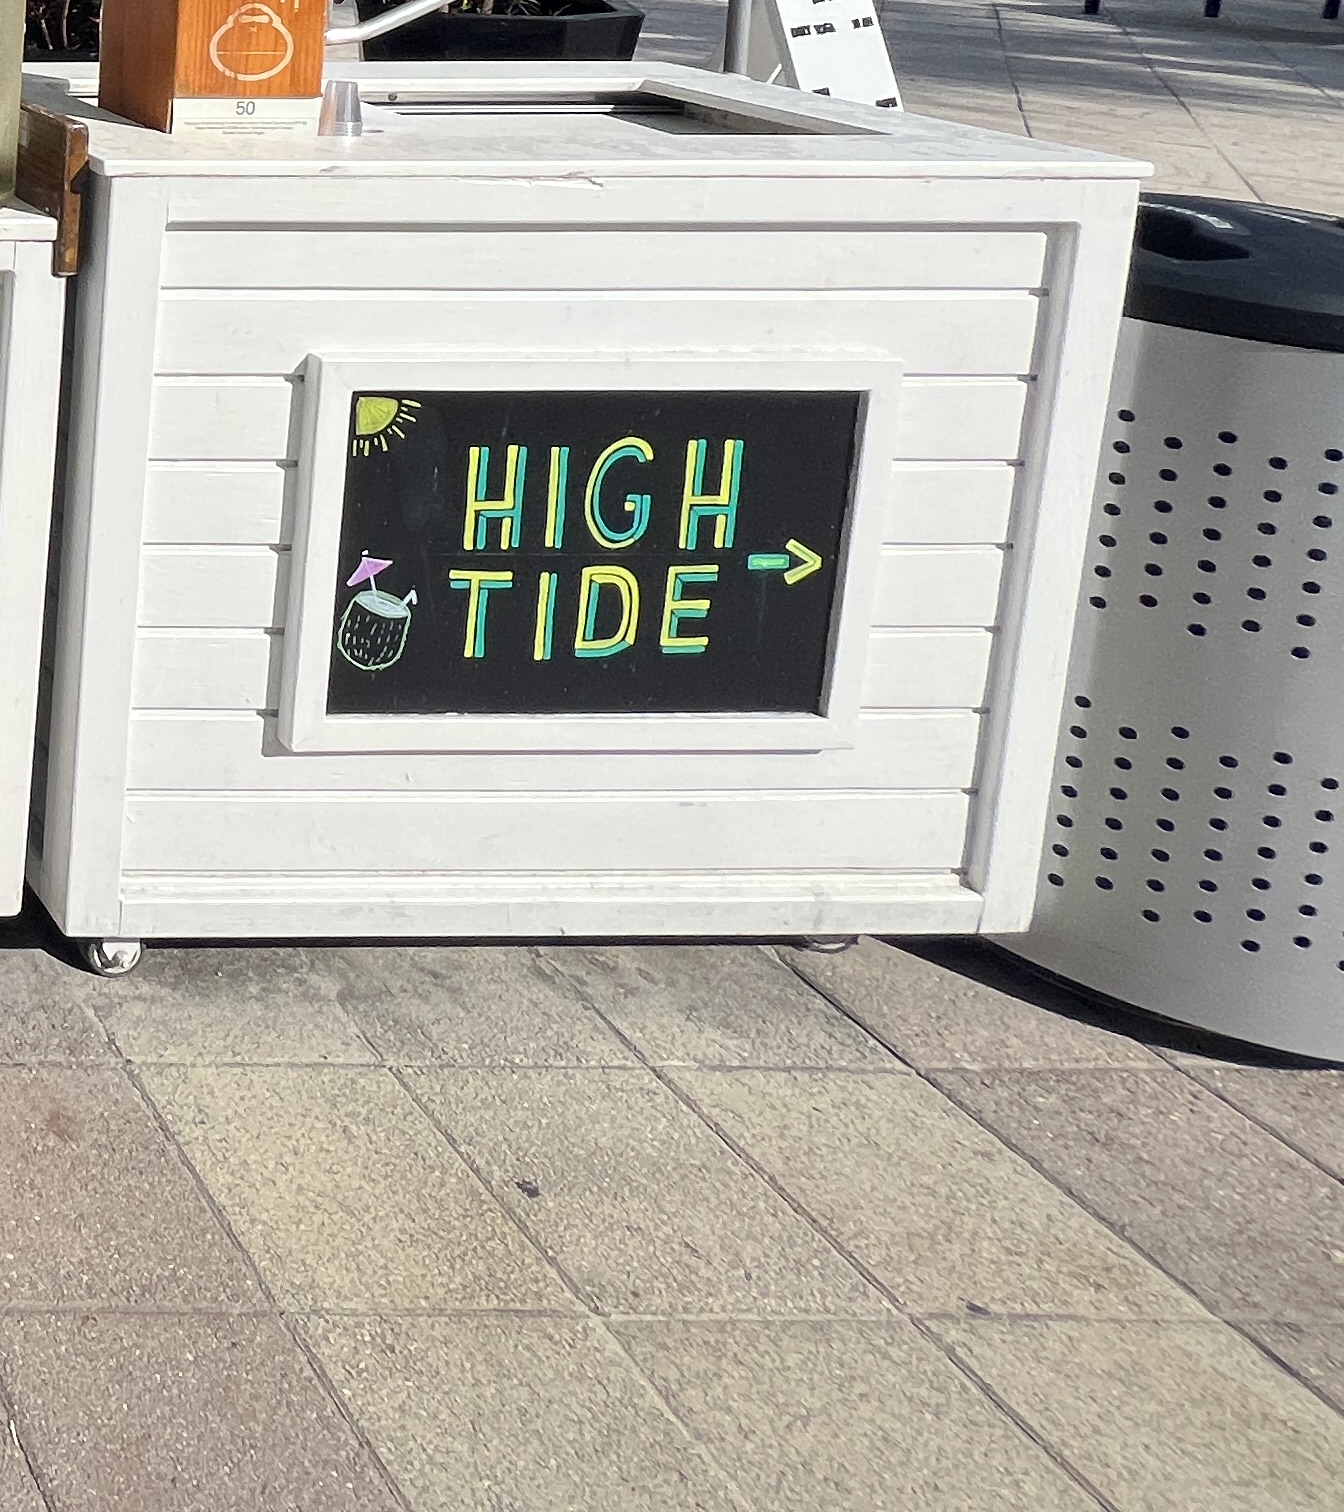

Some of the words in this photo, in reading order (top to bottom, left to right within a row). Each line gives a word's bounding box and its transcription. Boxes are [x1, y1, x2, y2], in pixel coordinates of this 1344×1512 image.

[235, 100, 256, 116] 50
[462, 436, 745, 551] HIGH
[448, 564, 720, 662] TIDE
